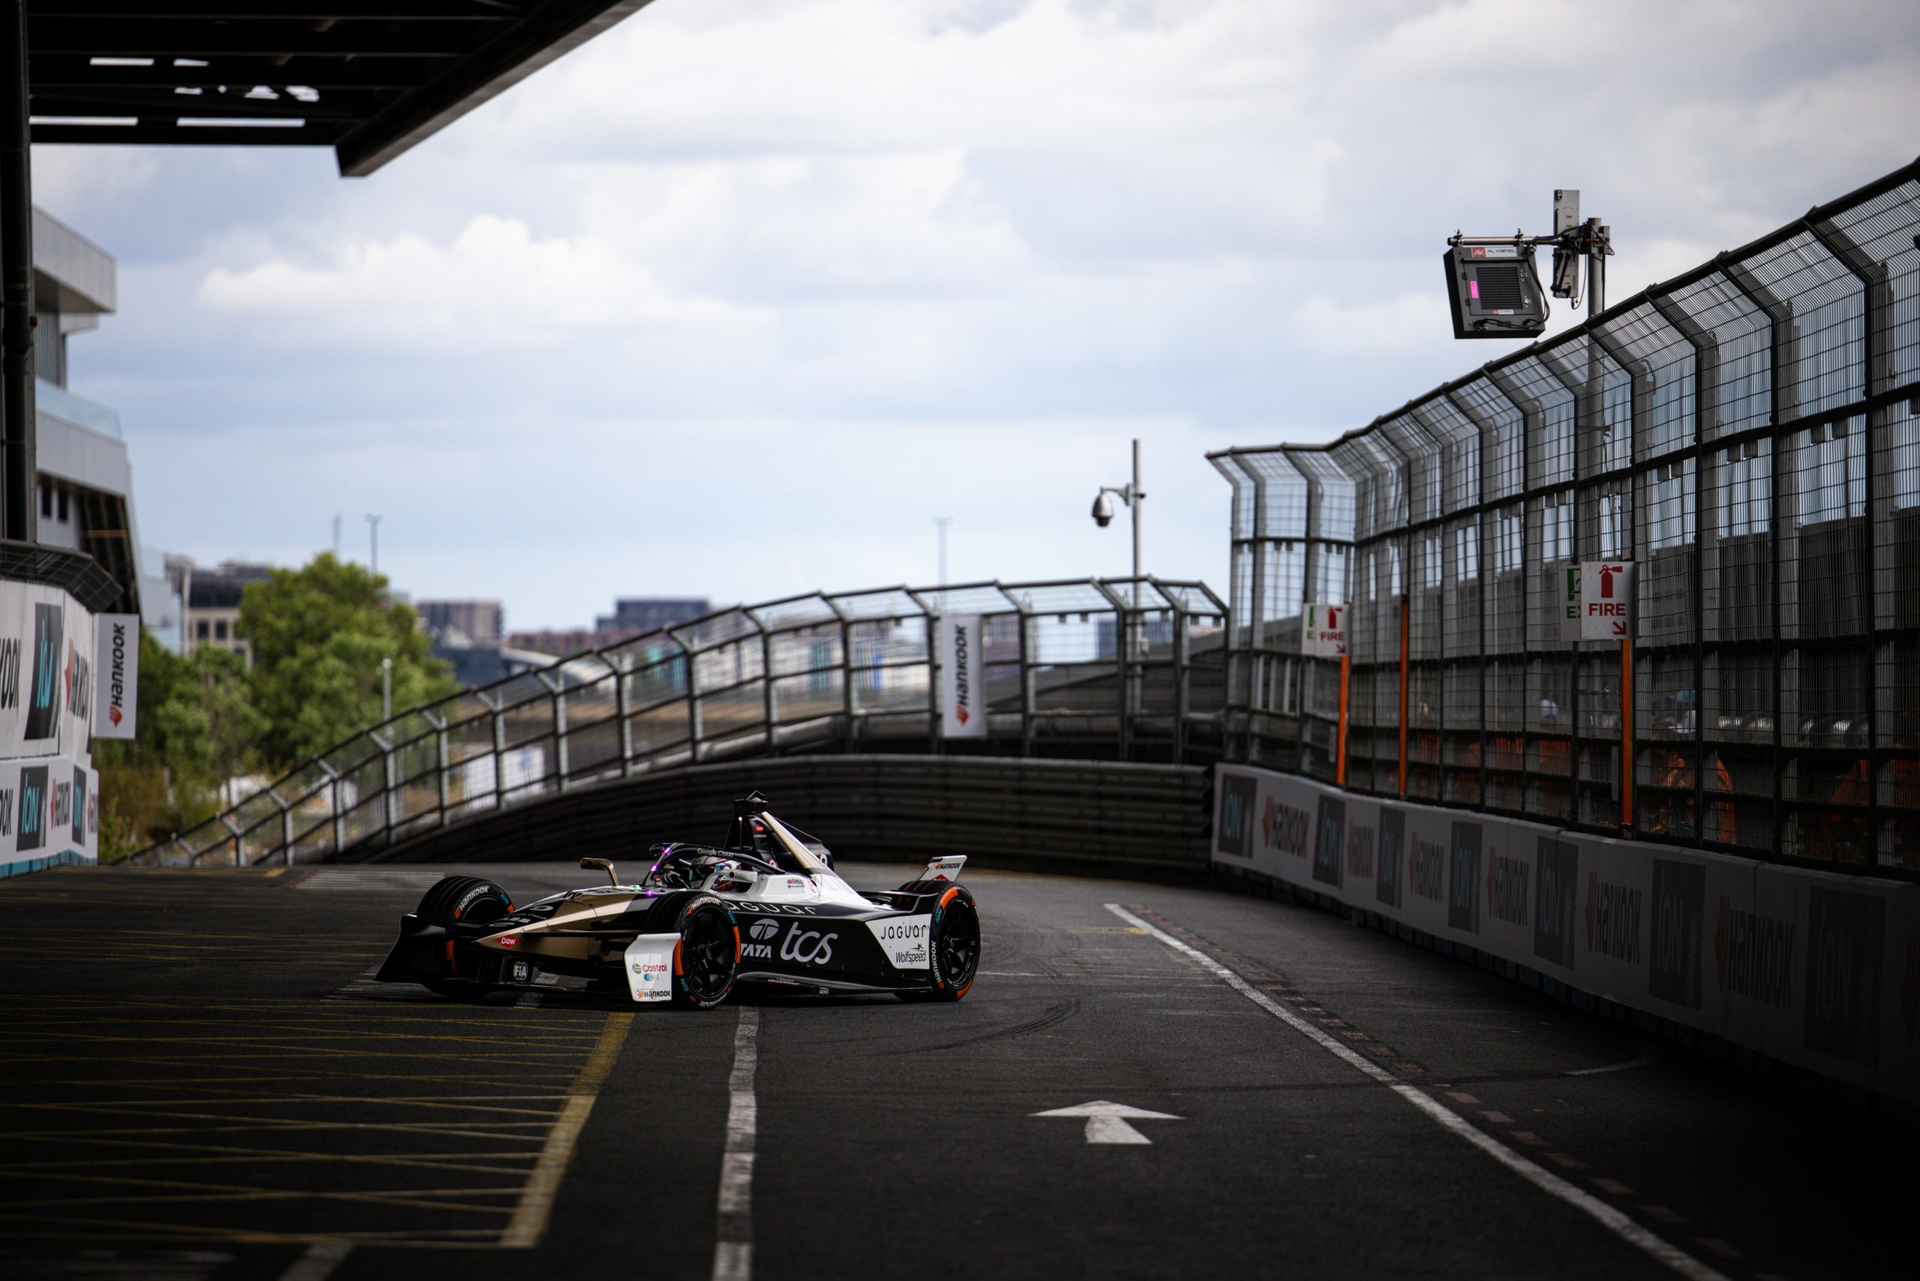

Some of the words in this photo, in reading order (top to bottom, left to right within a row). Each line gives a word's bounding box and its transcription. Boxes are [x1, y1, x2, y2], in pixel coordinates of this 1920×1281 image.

[1588, 603, 1626, 617] FIRE
[1320, 631, 1345, 642] FIRE
[697, 847, 717, 856] Google
[780, 921, 838, 965] tcs
[740, 942, 772, 959] TATA
[895, 951, 927, 966] Wolfspeed
[642, 964, 668, 973] Castrol
